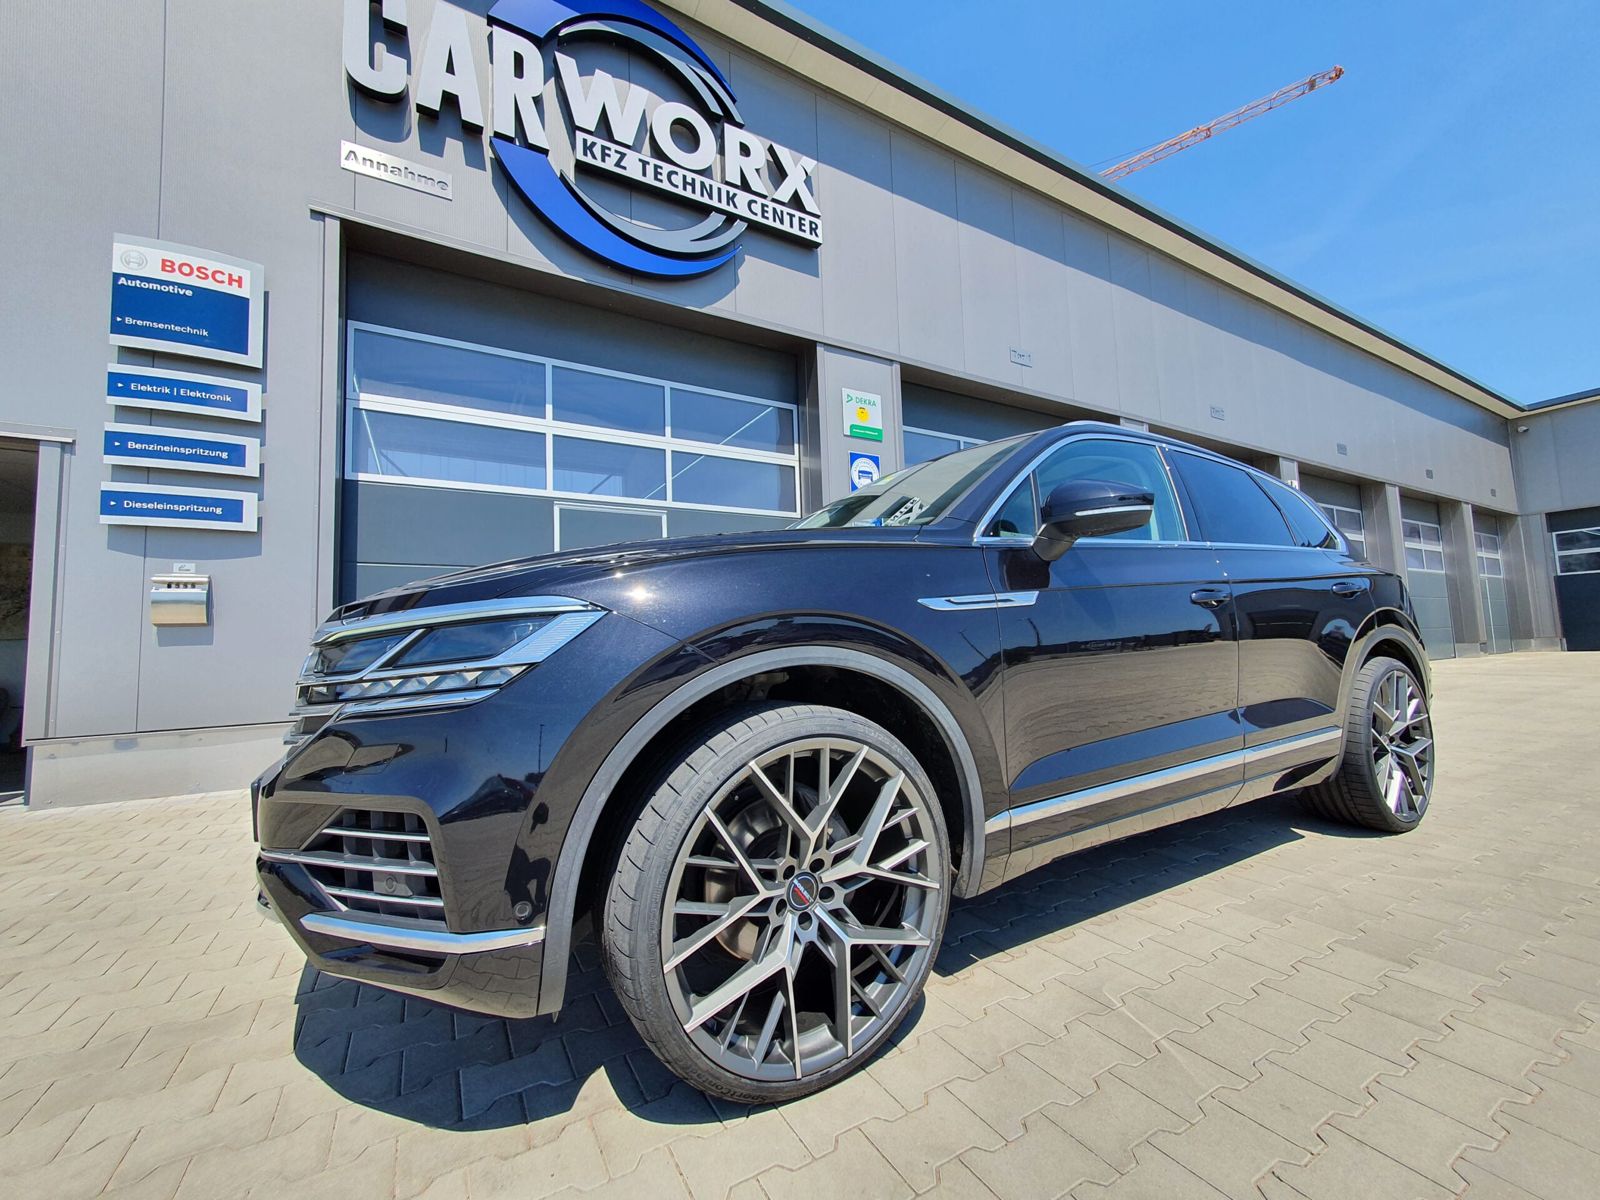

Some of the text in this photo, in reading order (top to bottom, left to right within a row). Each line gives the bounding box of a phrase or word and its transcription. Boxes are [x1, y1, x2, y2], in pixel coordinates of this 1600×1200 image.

[344, 149, 449, 191] Annahme
[582, 138, 819, 238] KFZ TECHNIK CENTER
[160, 258, 243, 289] BOSCH
[117, 276, 193, 297] Automotive
[125, 316, 209, 337] Bremsentechnik
[130, 382, 171, 395] Elektrik
[180, 388, 232, 403] Elektronik
[855, 396, 877, 407] DEKRA
[127, 441, 229, 459] Benzineinspritzung
[123, 500, 223, 515] Dieseleinspritzung
